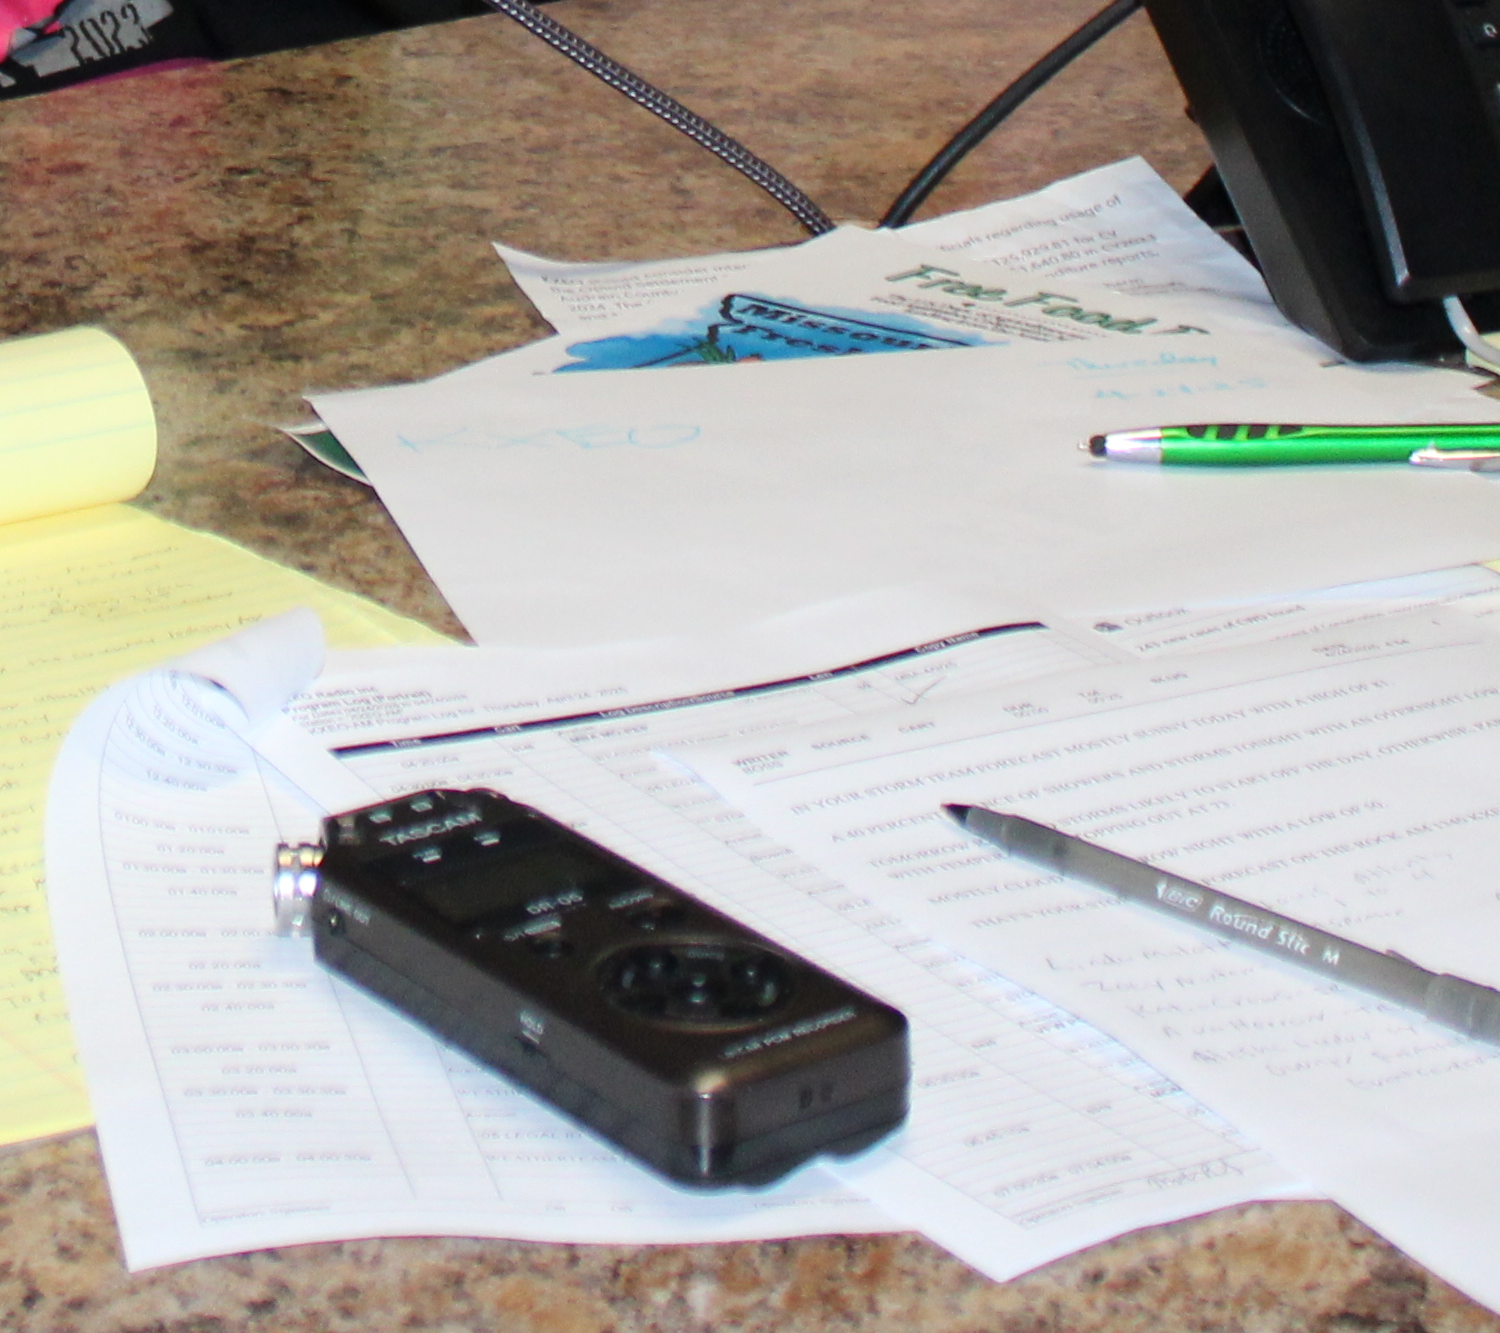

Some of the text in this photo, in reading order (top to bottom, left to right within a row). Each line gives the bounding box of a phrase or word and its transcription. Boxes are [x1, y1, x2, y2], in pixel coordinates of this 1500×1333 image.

[886, 263, 1007, 301] Free
[1003, 290, 1158, 334] Food
[808, 791, 868, 809] YOUR
[859, 777, 928, 797] STORM
[378, 808, 484, 846] TASCAM
[1208, 902, 1341, 967] Round Stic M
